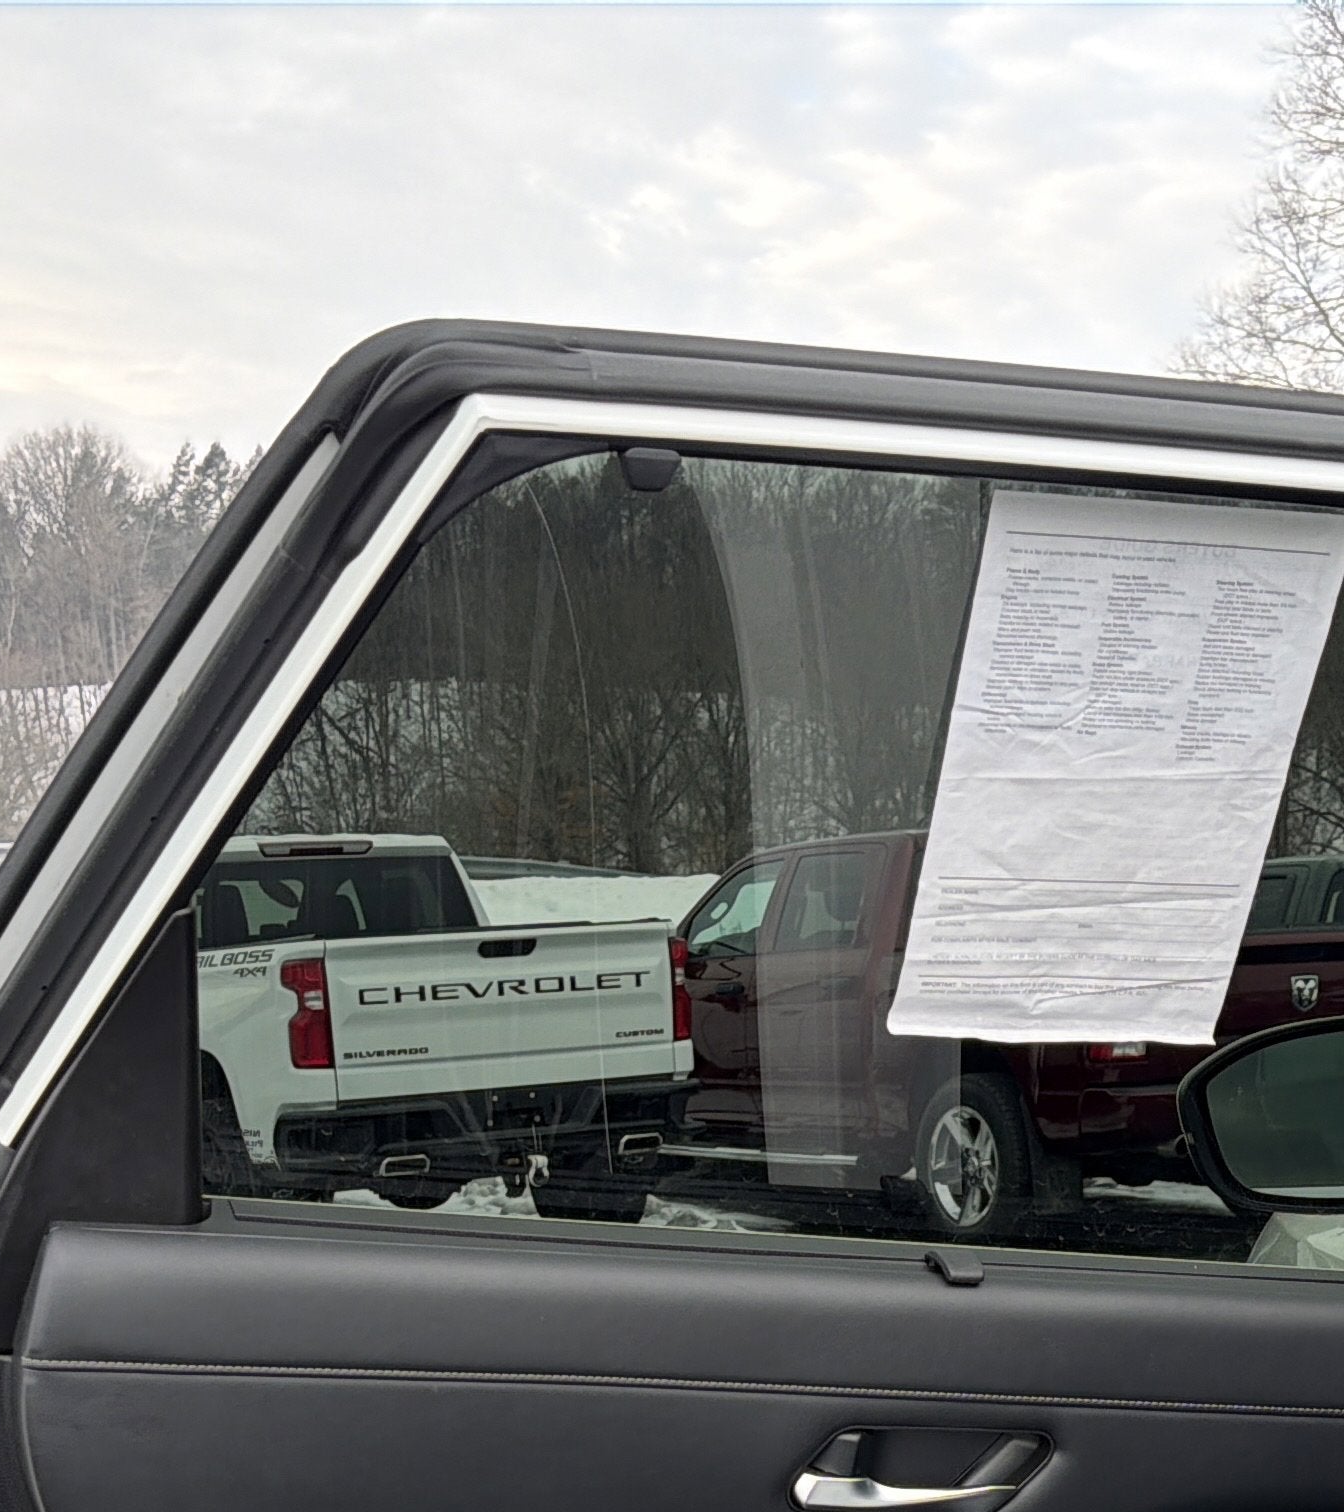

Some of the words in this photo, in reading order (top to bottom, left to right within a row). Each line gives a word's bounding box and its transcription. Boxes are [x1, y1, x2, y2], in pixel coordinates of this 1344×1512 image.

[220, 949, 275, 967] BOSS
[358, 971, 650, 1006] CHEVROLET
[615, 1028, 664, 1038] CUSTOM
[343, 1046, 429, 1060] SILVERADO
